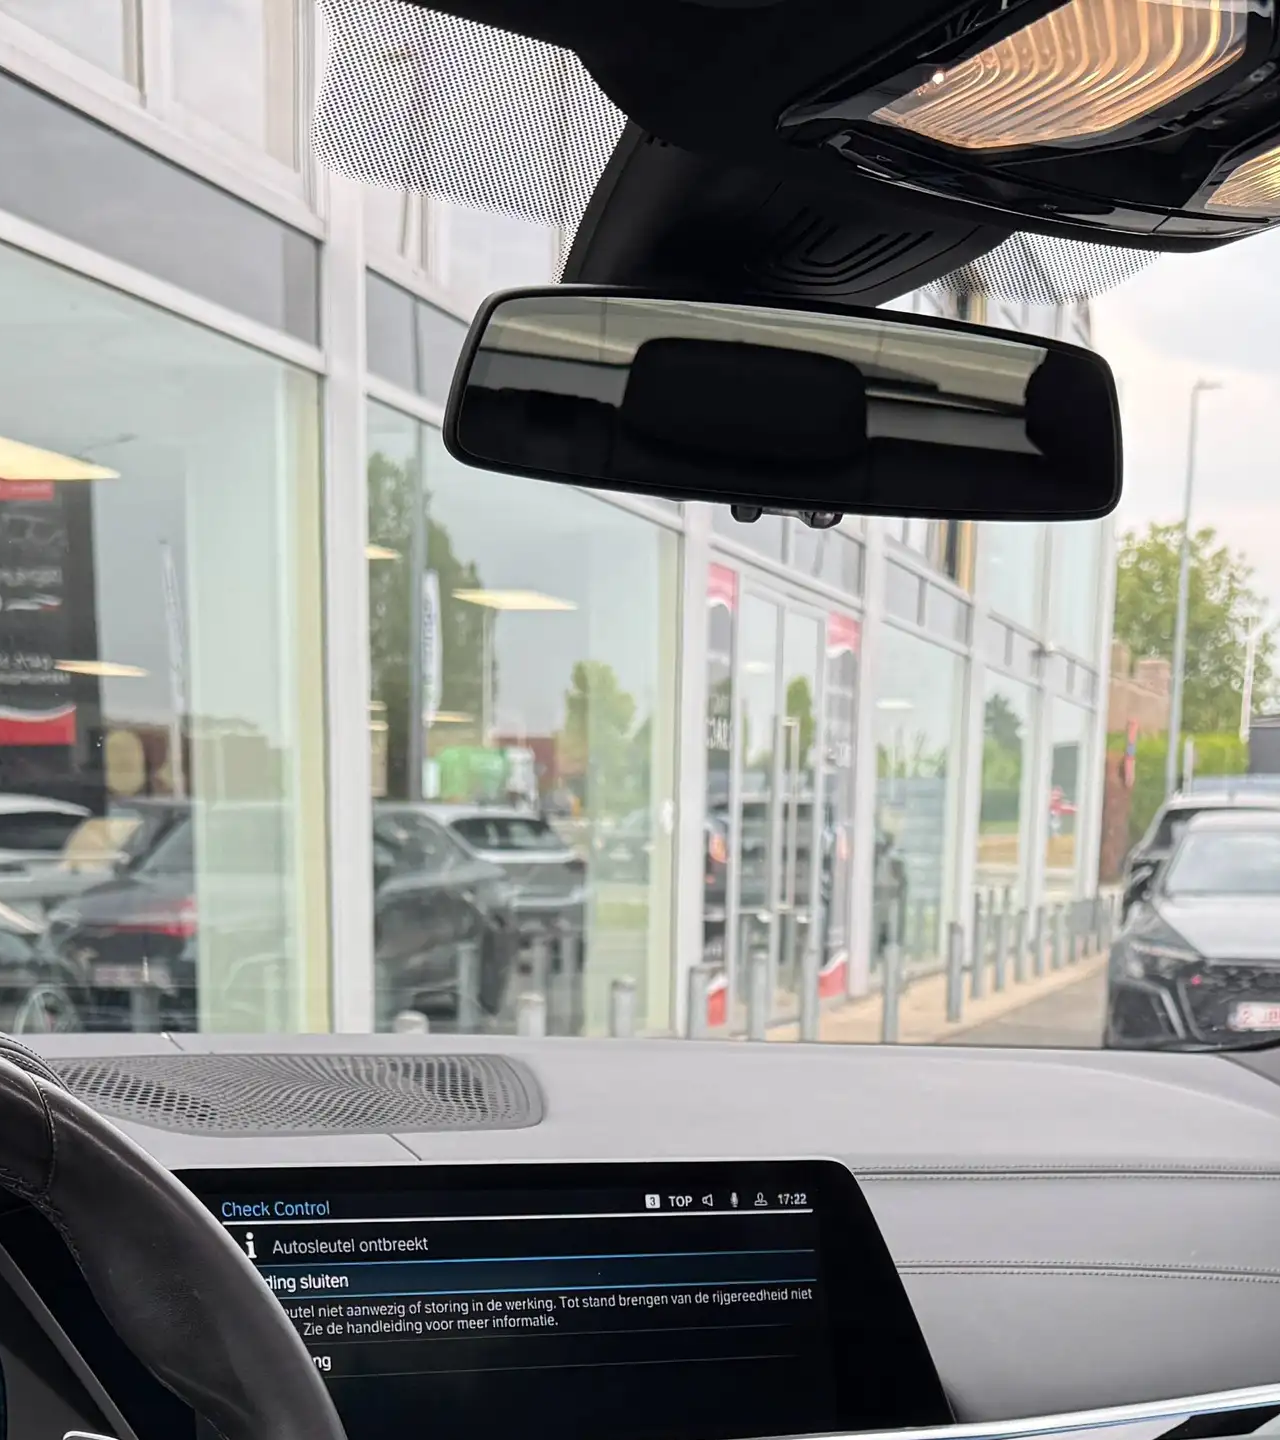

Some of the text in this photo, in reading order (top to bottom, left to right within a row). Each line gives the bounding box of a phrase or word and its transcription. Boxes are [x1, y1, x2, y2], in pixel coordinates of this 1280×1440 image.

[221, 1200, 330, 1217] Check Control
[668, 1195, 693, 1207] TOP
[778, 1193, 807, 1205] 17:22
[273, 1236, 428, 1254] Autosleutel ontbreekt
[300, 1274, 349, 1289] sluiten
[318, 1303, 345, 1318] niet
[346, 1302, 405, 1318] aanwezig
[409, 1300, 422, 1315] of
[424, 1299, 469, 1315] storing
[472, 1300, 483, 1312] in
[487, 1299, 503, 1312] de
[505, 1297, 557, 1312] werking.
[559, 1295, 580, 1309] Tot
[583, 1294, 616, 1308] stand
[619, 1293, 668, 1308] brengen
[671, 1293, 691, 1305] van
[695, 1290, 709, 1304] de
[713, 1289, 788, 1305] rijgereedheid
[791, 1287, 812, 1300] niet
[303, 1314, 559, 1336] Zie de handleiding voor meer informatie.
